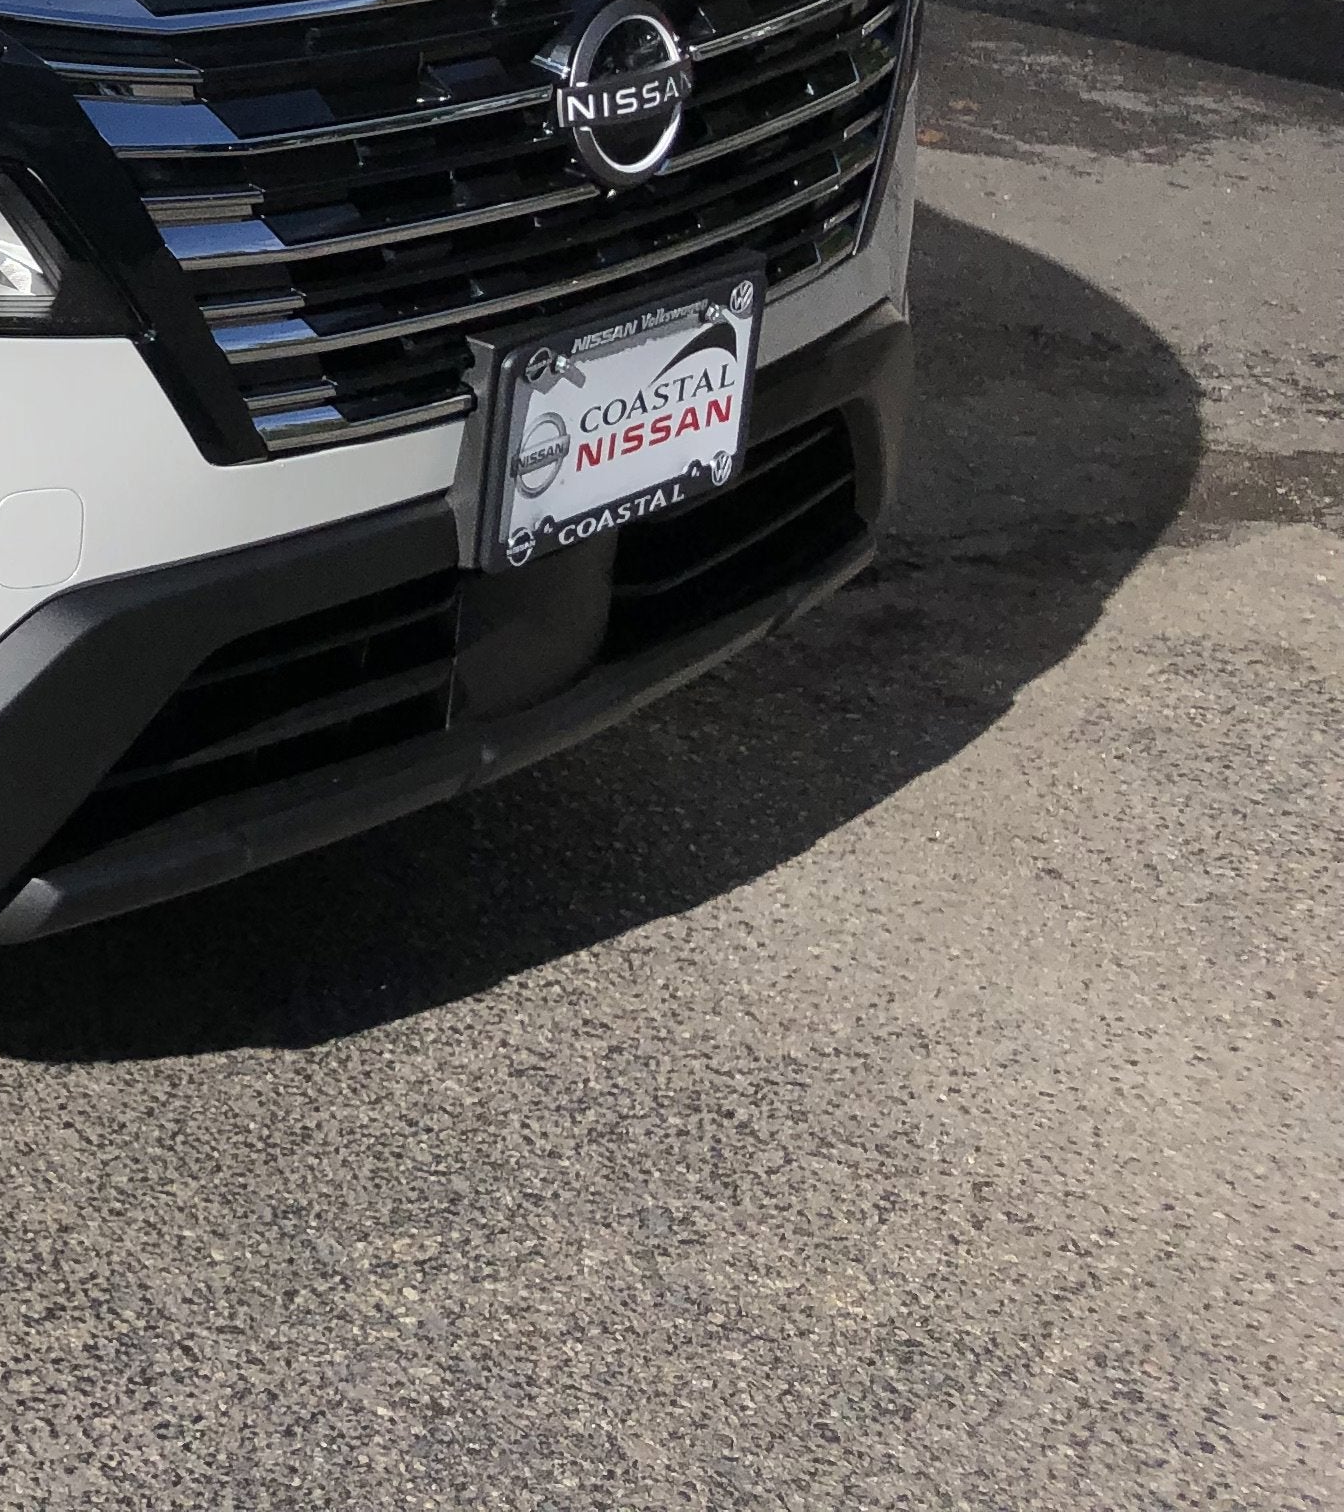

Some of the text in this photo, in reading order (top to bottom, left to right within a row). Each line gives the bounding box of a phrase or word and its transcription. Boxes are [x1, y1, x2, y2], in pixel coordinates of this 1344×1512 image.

[566, 70, 692, 122] NISSAN
[570, 319, 638, 354] NISSAN
[579, 364, 736, 434] COASTAL
[575, 394, 733, 472] NISSAN
[558, 483, 686, 546] COASTAL
